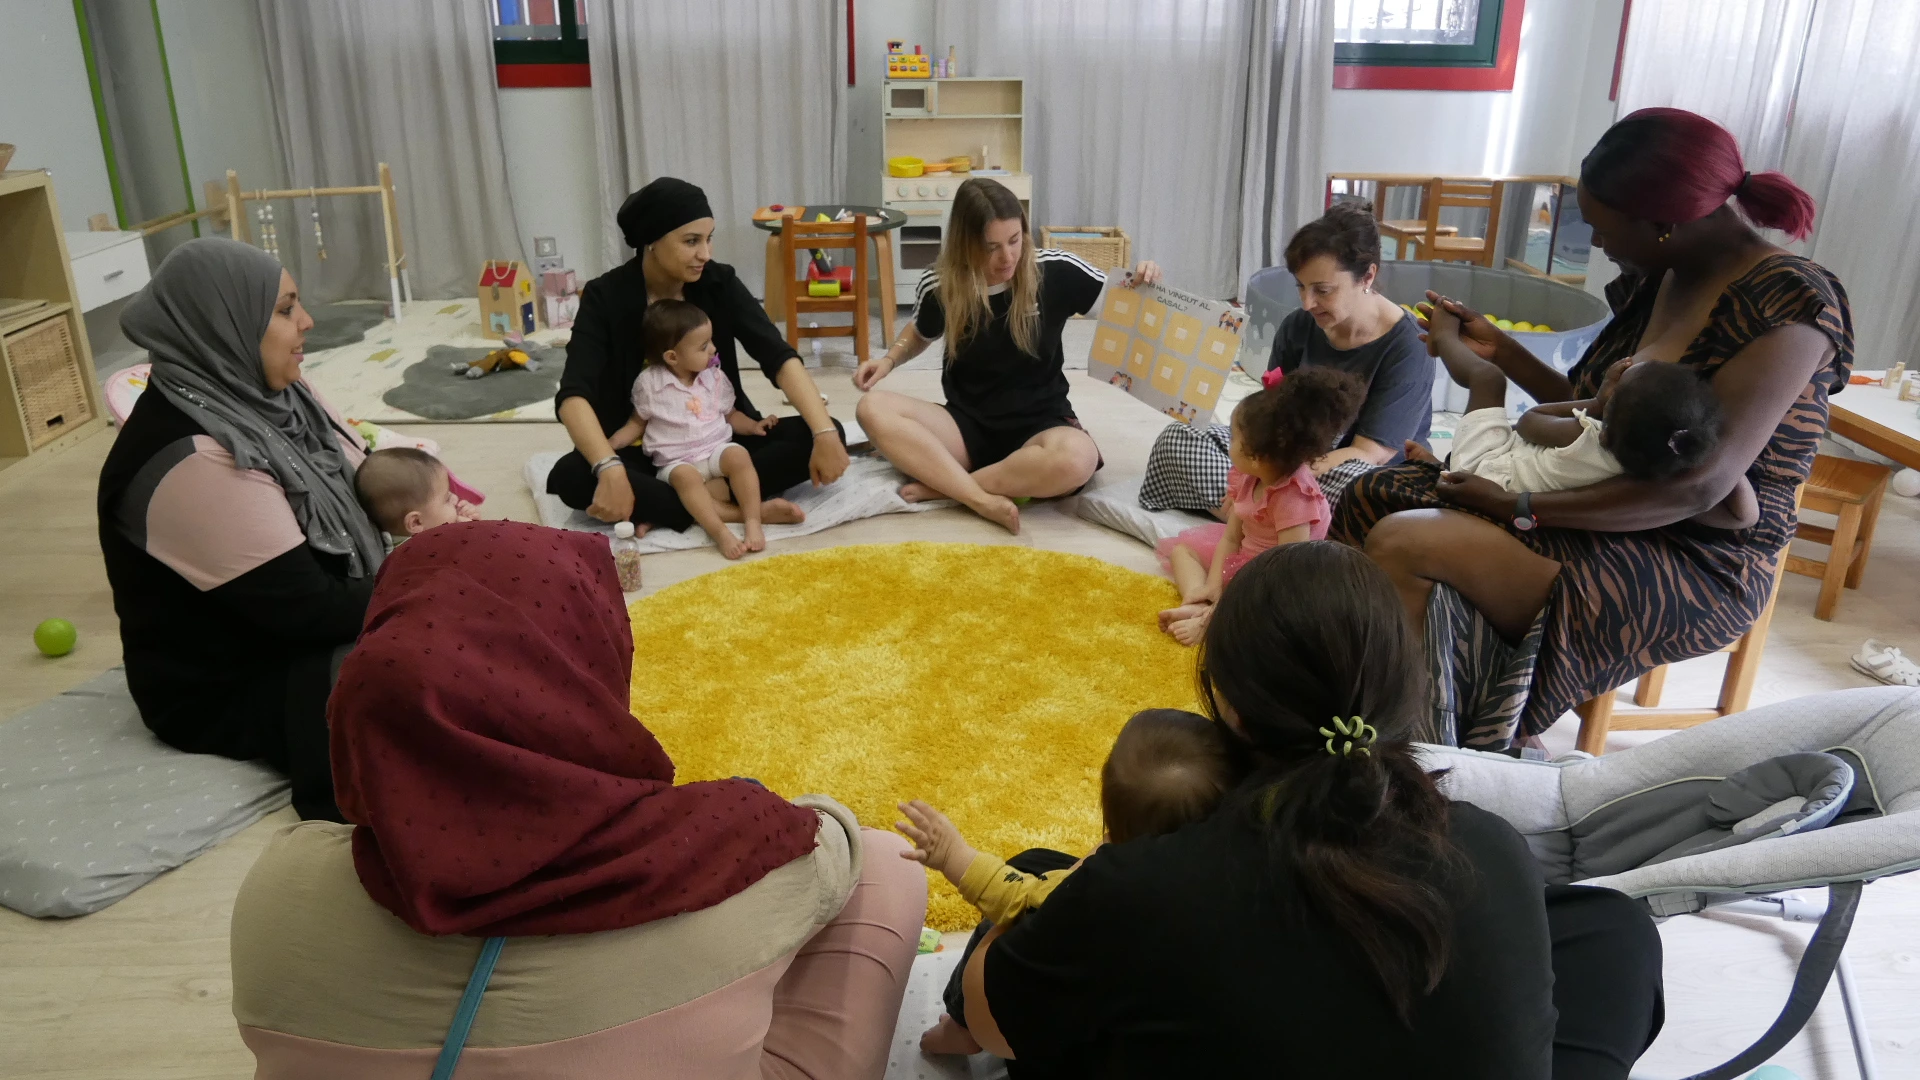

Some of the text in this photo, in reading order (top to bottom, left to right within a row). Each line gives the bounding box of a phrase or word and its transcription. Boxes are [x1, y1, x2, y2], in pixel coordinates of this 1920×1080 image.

[1156, 285, 1166, 294] HA
[1168, 289, 1199, 305] VINGUT
[1199, 302, 1211, 311] AL
[1156, 296, 1188, 312] CASAL?
